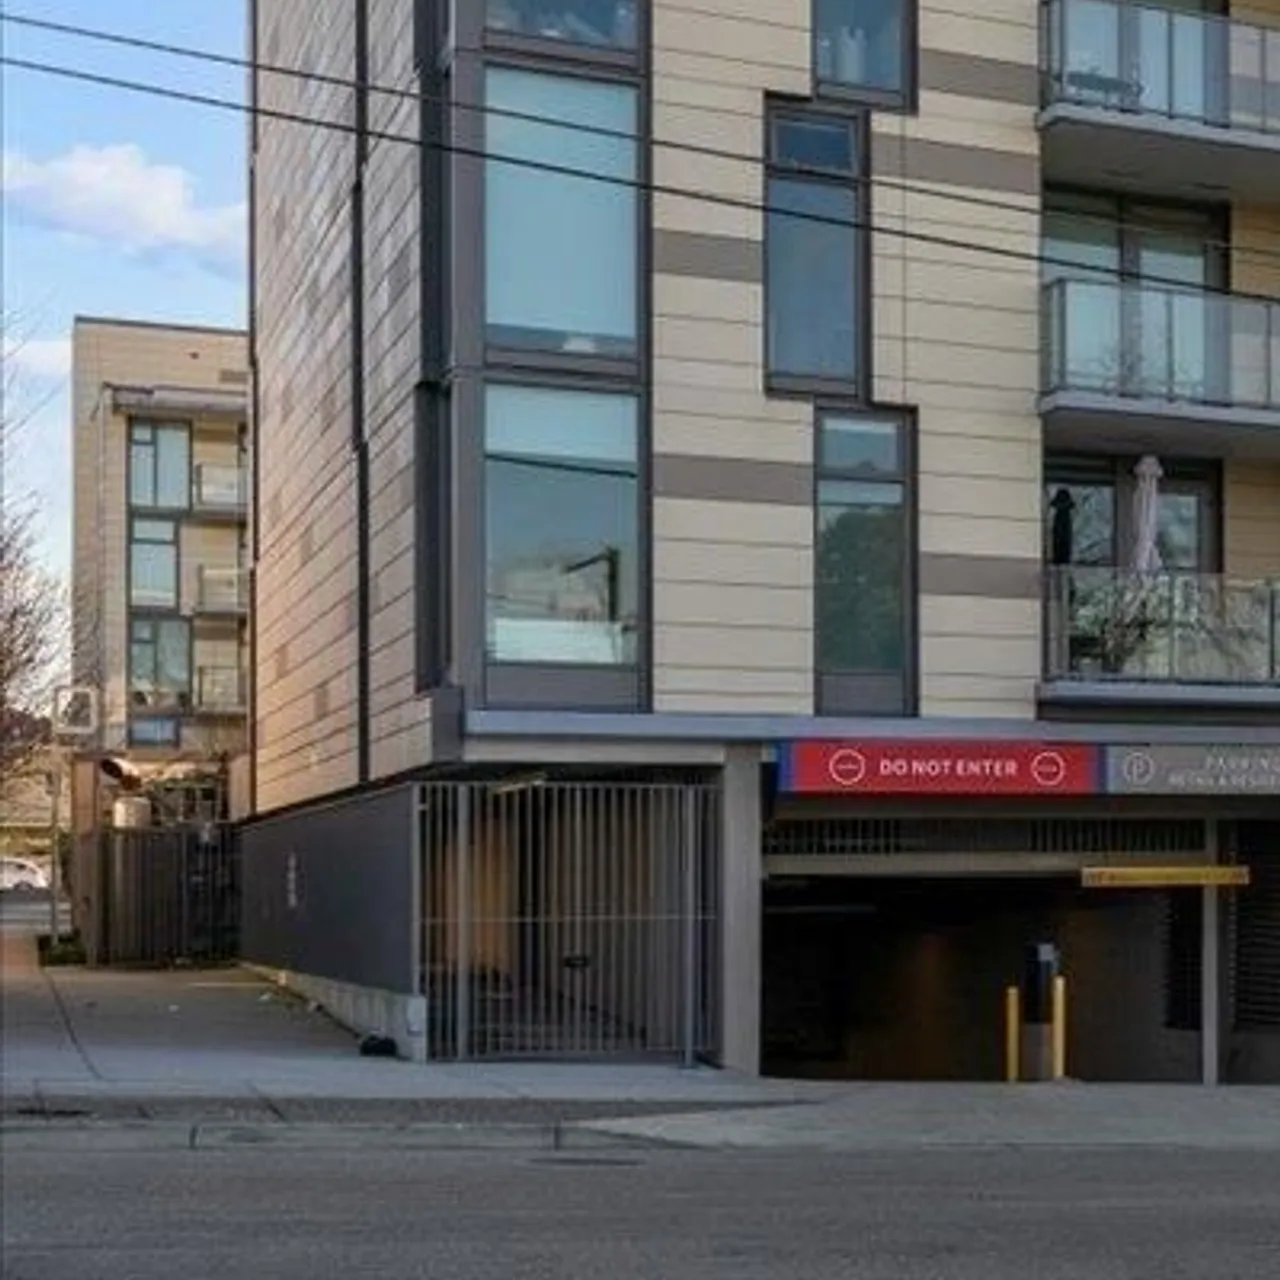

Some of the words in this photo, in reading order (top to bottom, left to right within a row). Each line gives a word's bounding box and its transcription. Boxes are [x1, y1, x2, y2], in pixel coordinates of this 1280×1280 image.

[880, 758, 908, 777] DO
[912, 758, 952, 777] NOT
[956, 758, 1018, 777] ENTER
